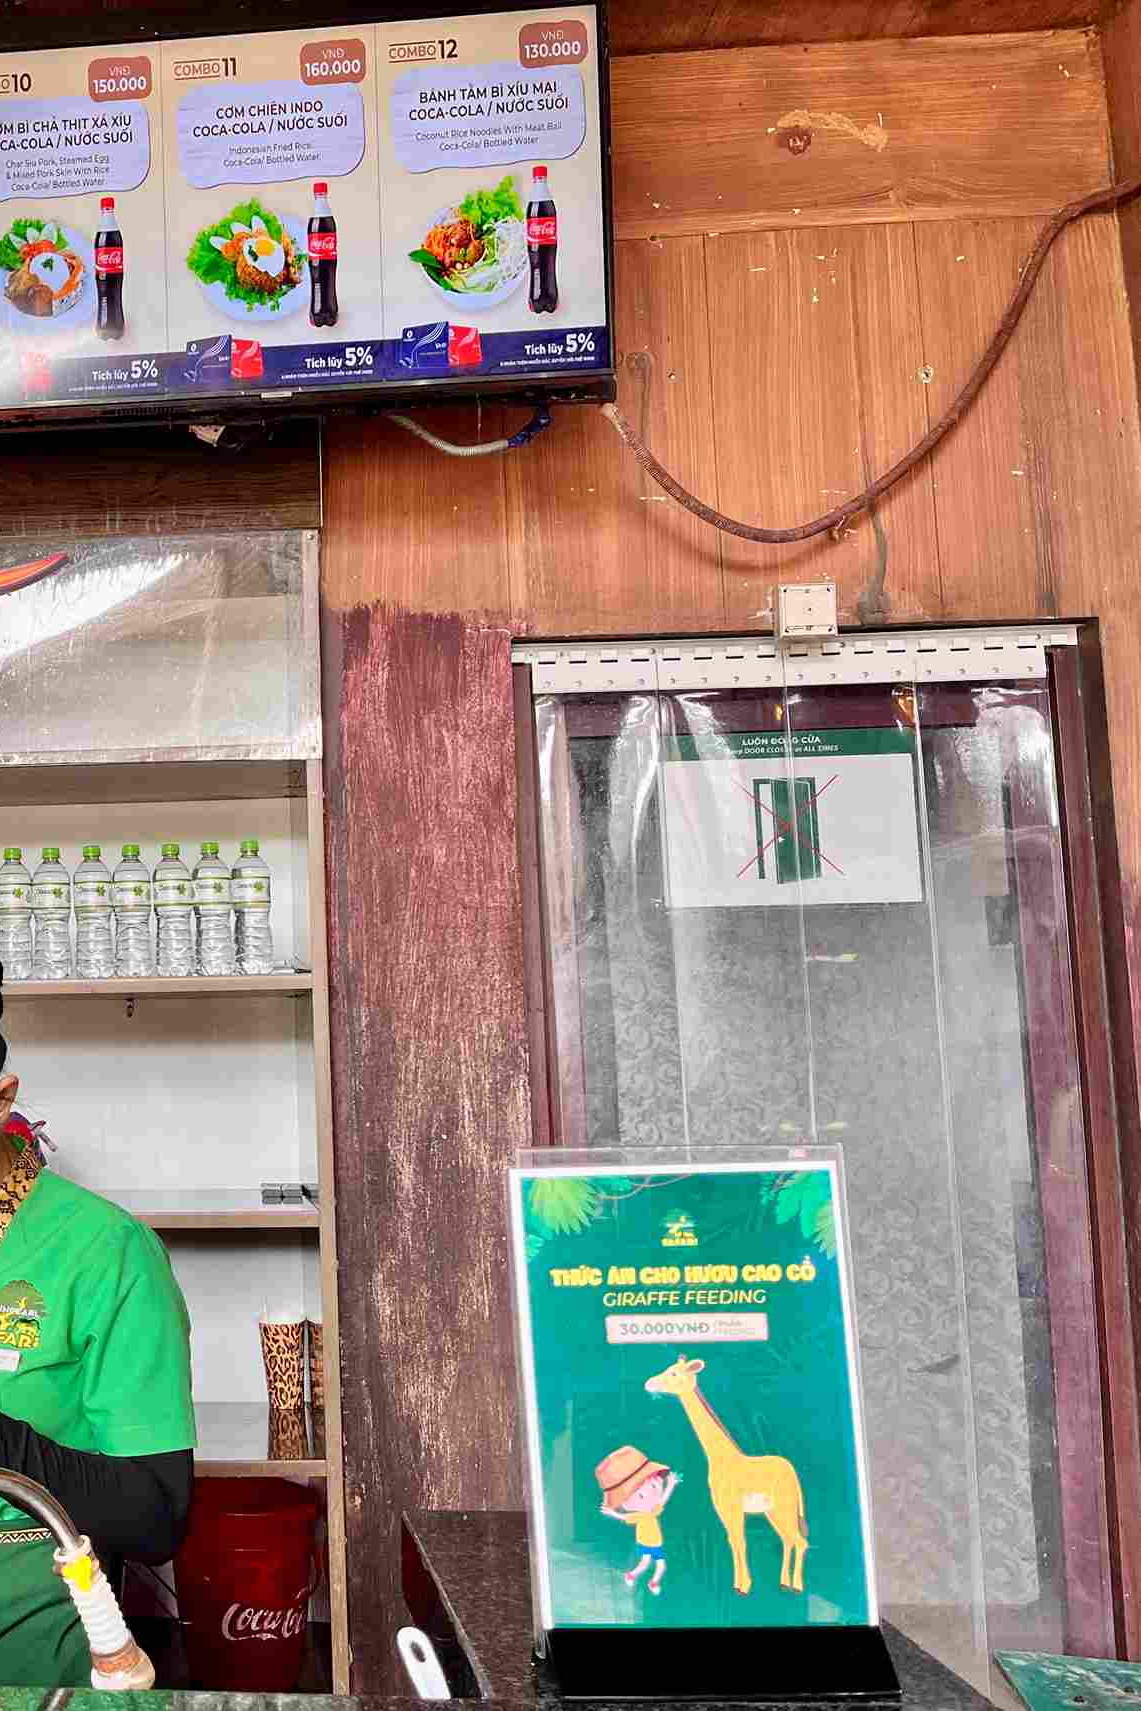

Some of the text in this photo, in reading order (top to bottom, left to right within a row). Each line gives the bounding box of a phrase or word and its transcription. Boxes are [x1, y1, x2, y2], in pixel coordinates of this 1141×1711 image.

[389, 40, 458, 59] COMBO 12
[524, 43, 580, 59] 130.000
[174, 58, 236, 76] COMBO 11
[305, 60, 361, 77] 160.000
[12, 73, 31, 92] 10
[93, 77, 146, 94] 150.000
[291, 101, 323, 114] INDO
[409, 104, 484, 121] COCA-COLA
[193, 123, 266, 137] COCA-COLA
[565, 333, 595, 352] 5%
[345, 346, 372, 366] 5%
[131, 359, 158, 379] 5%
[640, 1267, 681, 1284] CHO
[742, 1265, 782, 1282] CAO
[603, 1289, 766, 1307] GIRAFFE FEEDING
